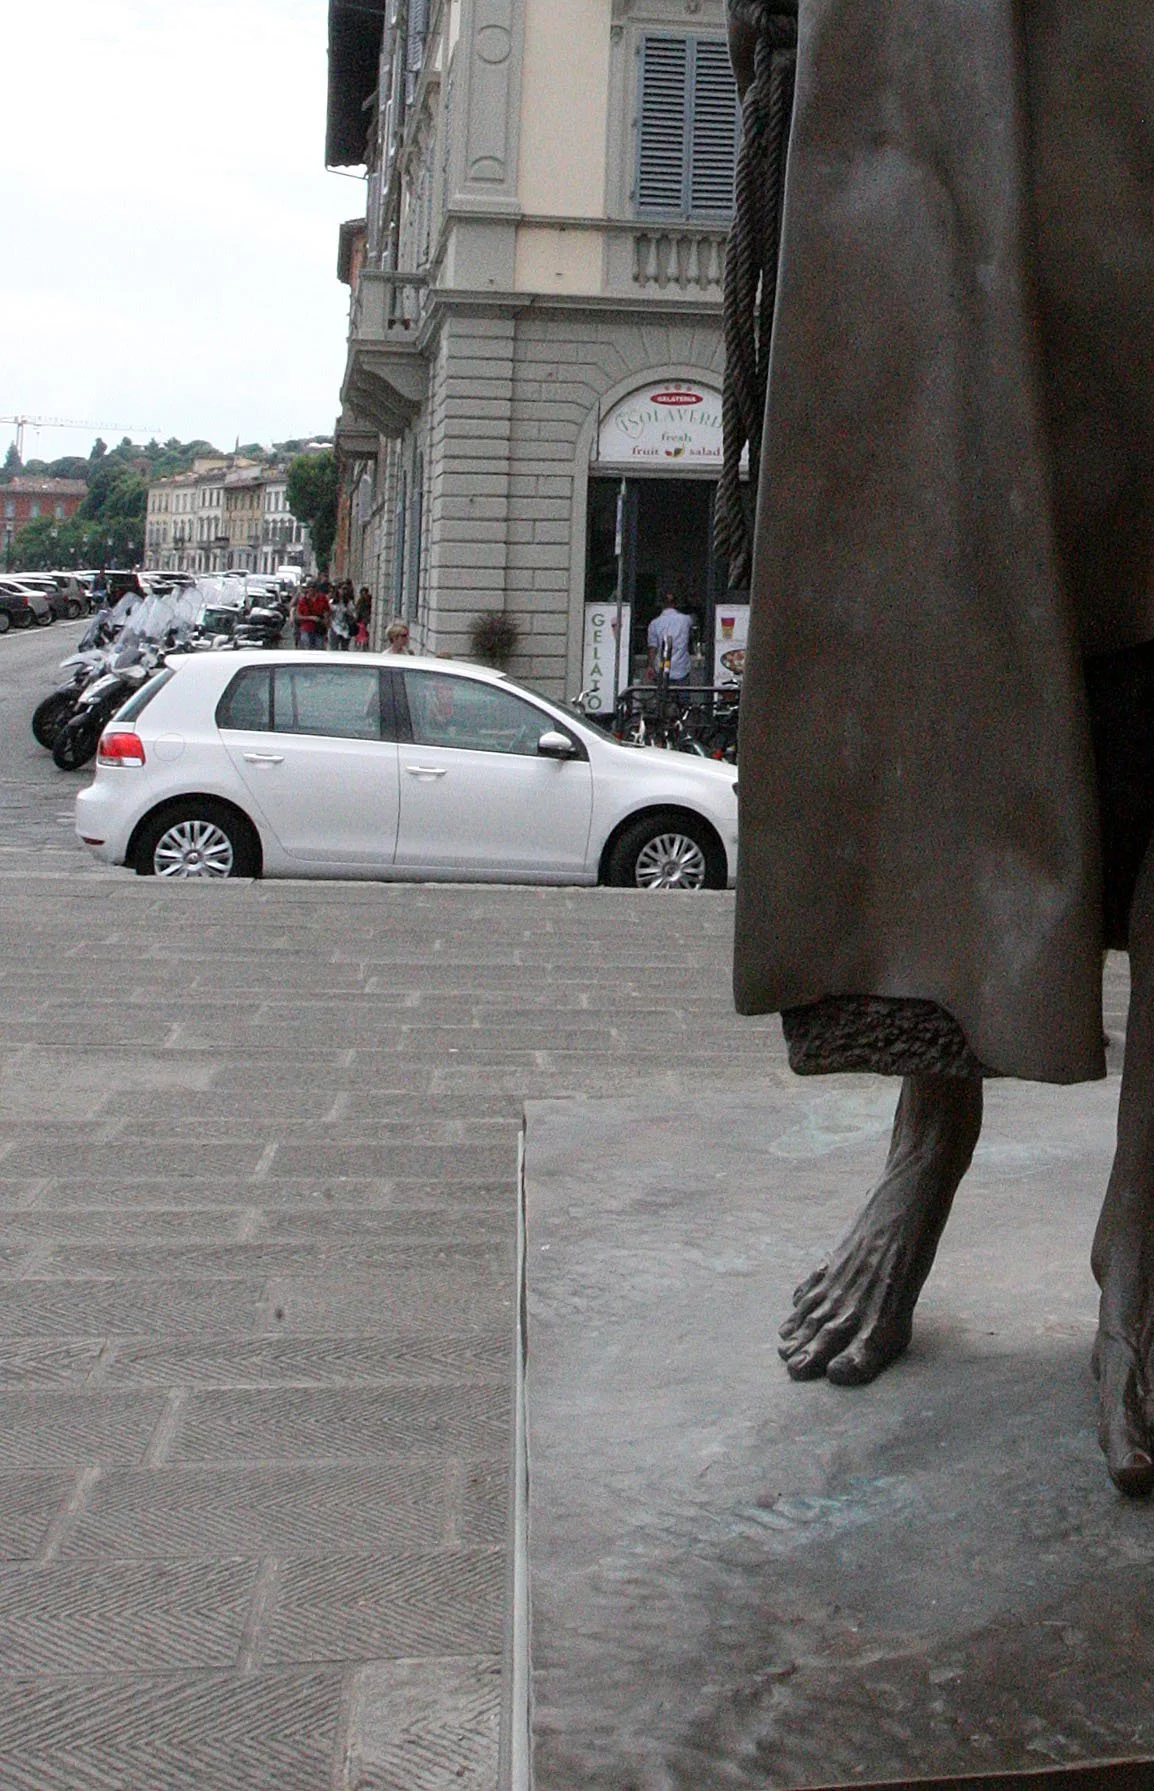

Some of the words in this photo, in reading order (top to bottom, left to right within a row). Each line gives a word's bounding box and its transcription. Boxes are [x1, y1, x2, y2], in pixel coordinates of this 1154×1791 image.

[620, 408, 723, 432] ISOLAVERD
[661, 432, 692, 443] fresh
[632, 445, 659, 456] fruit
[689, 447, 721, 457] salad
[588, 613, 605, 711] GELATO
